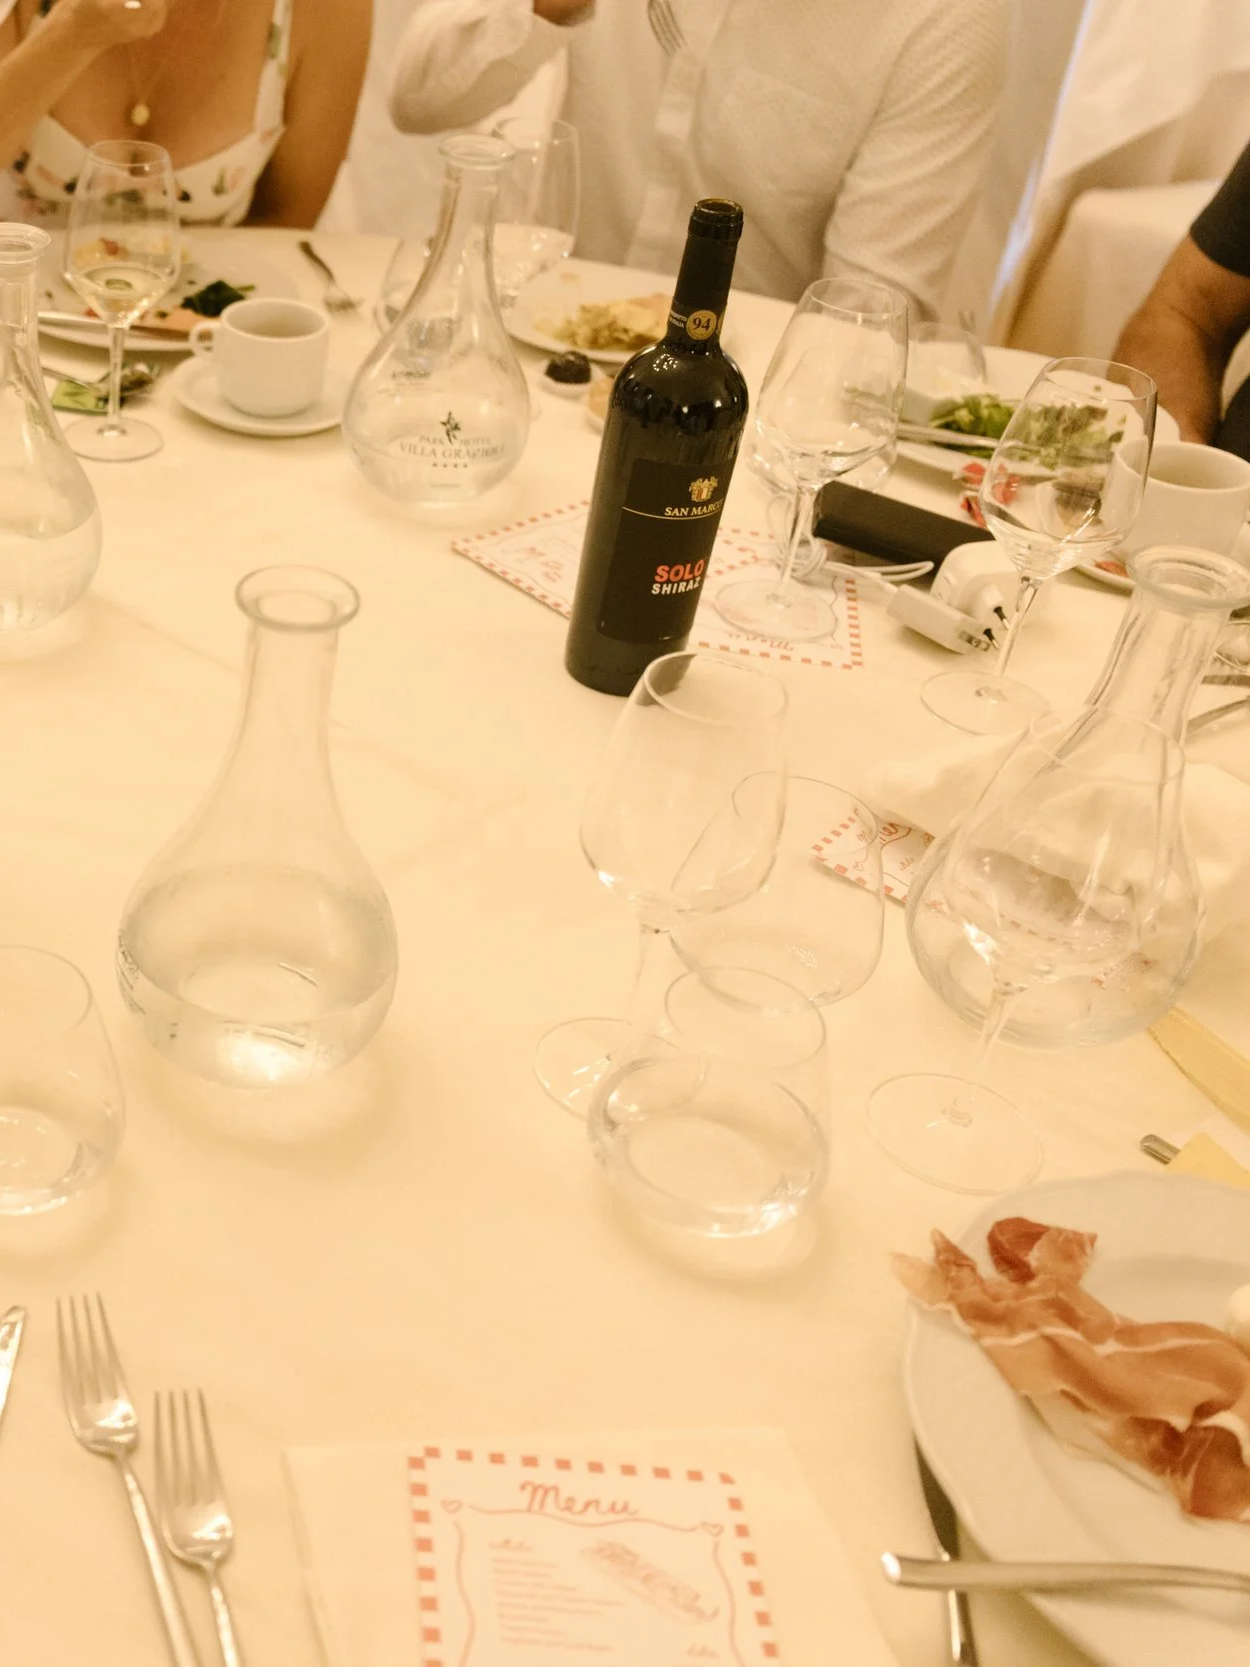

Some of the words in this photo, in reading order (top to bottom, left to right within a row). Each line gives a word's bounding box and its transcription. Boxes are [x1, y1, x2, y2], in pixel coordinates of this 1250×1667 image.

[692, 317, 712, 331] 94
[399, 442, 438, 459] VILLA
[664, 506, 689, 516] SAN
[654, 559, 705, 583] SOLO
[651, 576, 701, 595] SHIRAZ
[519, 1480, 639, 1517] Menu
